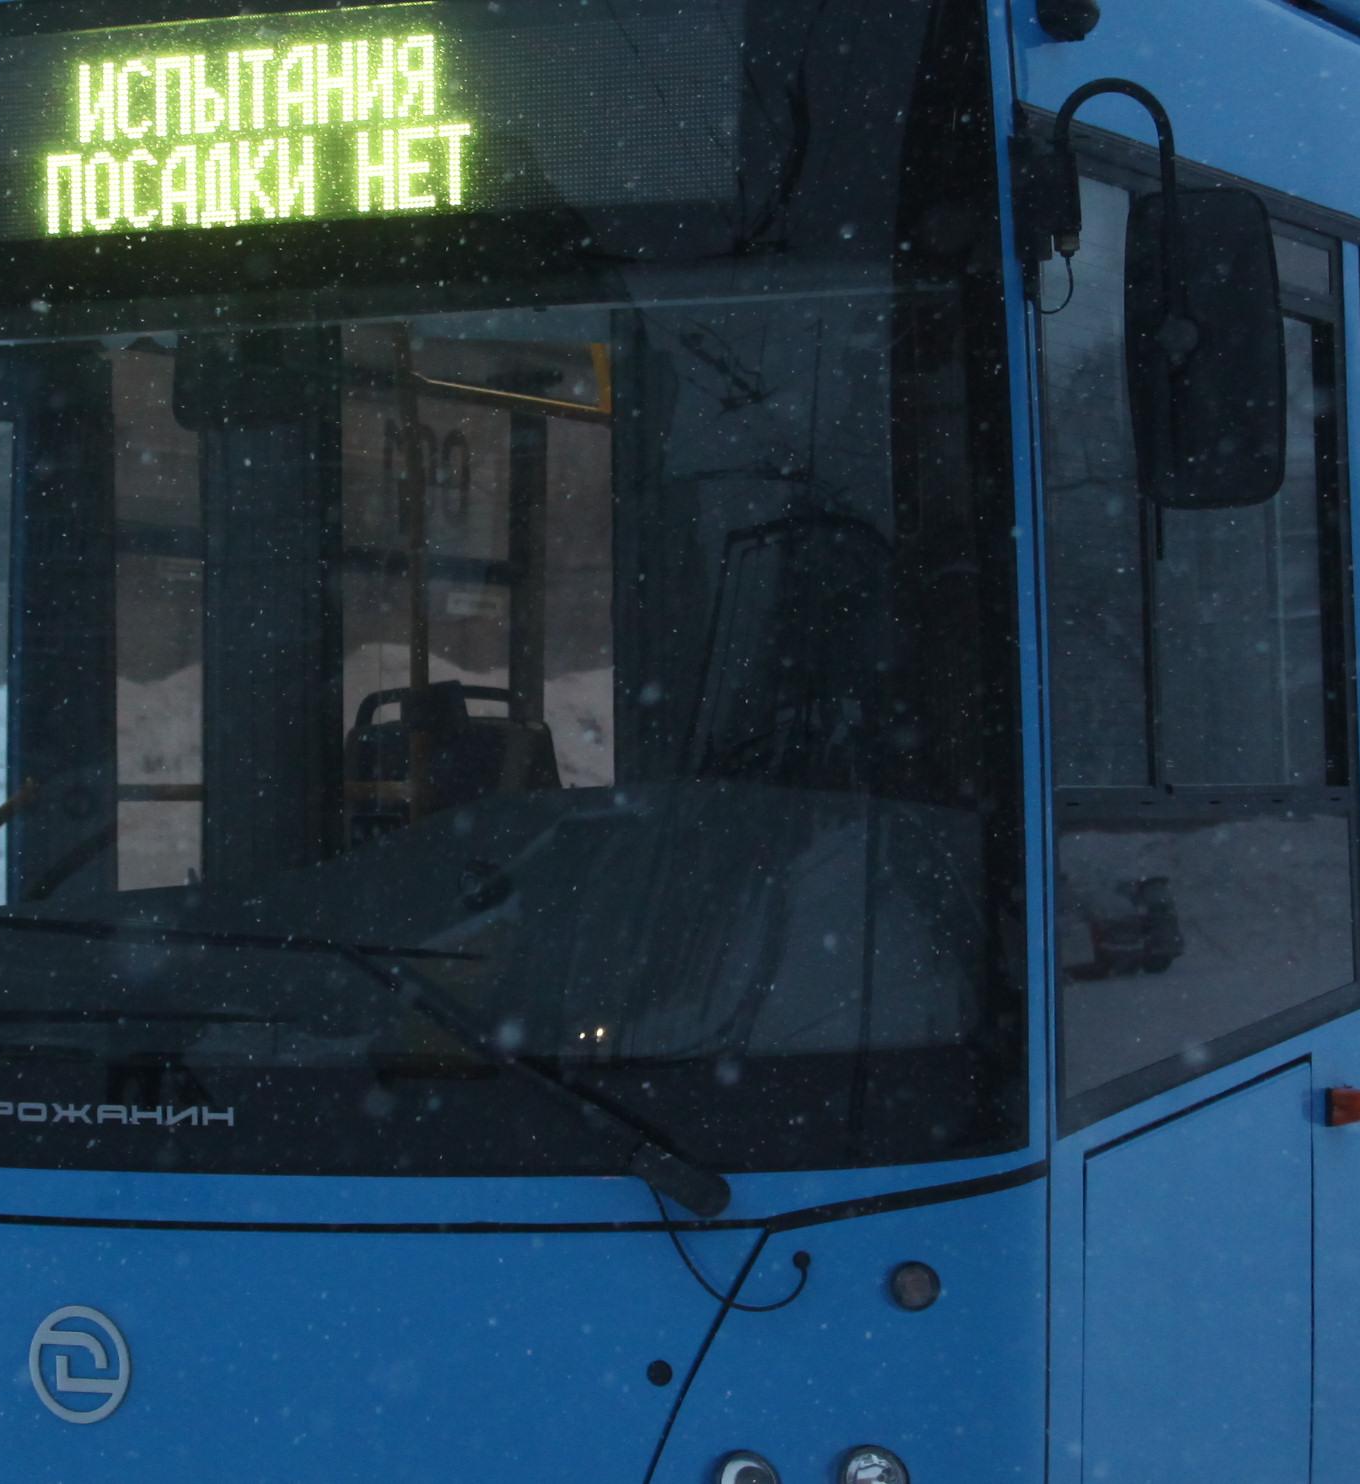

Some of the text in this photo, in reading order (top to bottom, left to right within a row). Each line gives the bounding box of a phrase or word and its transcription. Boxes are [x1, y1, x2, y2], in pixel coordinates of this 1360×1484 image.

[77, 34, 436, 144] ИСПЫТАНИЯ
[46, 123, 473, 236] ПОСАДКИ НЕТ
